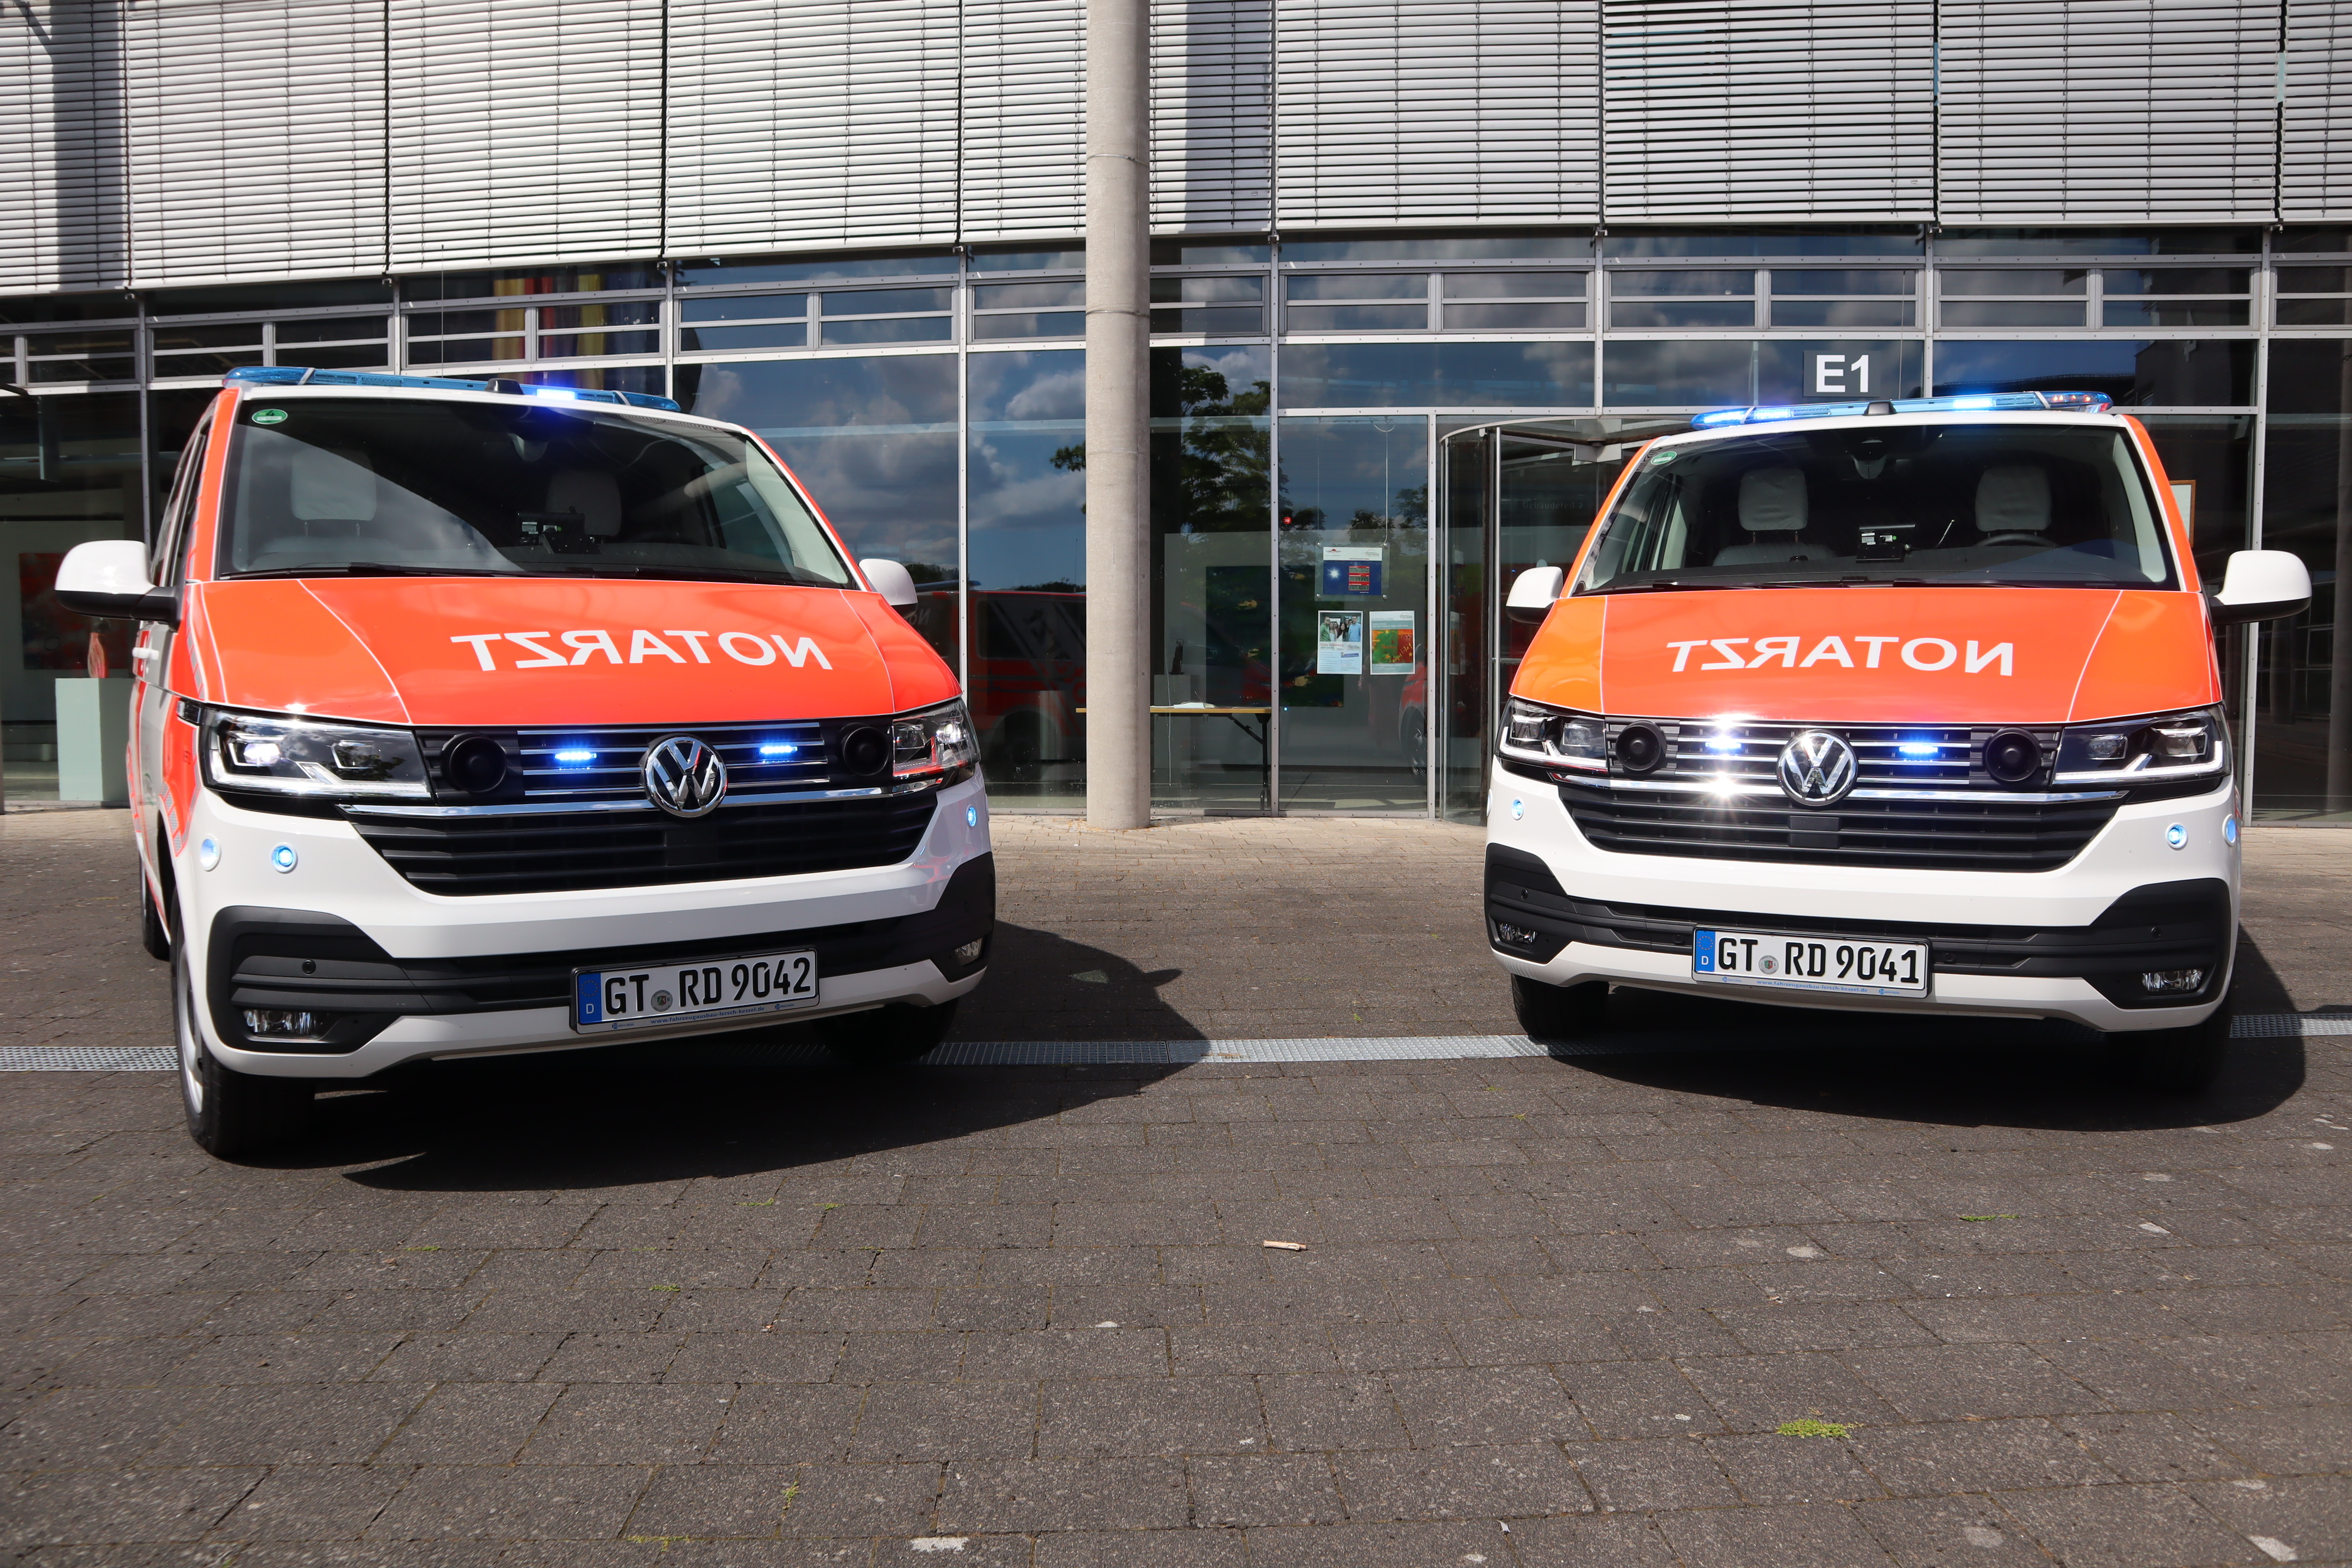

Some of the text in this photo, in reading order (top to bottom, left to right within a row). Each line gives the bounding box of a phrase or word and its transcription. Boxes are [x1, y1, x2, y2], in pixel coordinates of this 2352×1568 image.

[1817, 354, 1868, 393] E1
[1701, 956, 1709, 965] D
[1718, 937, 1758, 971] GT
[1785, 942, 1826, 977] RD
[1836, 945, 1919, 984] 9041
[605, 974, 649, 1015] GT
[679, 966, 721, 1007] RD
[731, 957, 811, 1001] 9042
[1757, 980, 1868, 993] www.fahrzeugausbau-lersch-kessel.de
[586, 1004, 594, 1014] D
[651, 1006, 765, 1024] www.fahrzeugausbau-lersch-kessel.de
